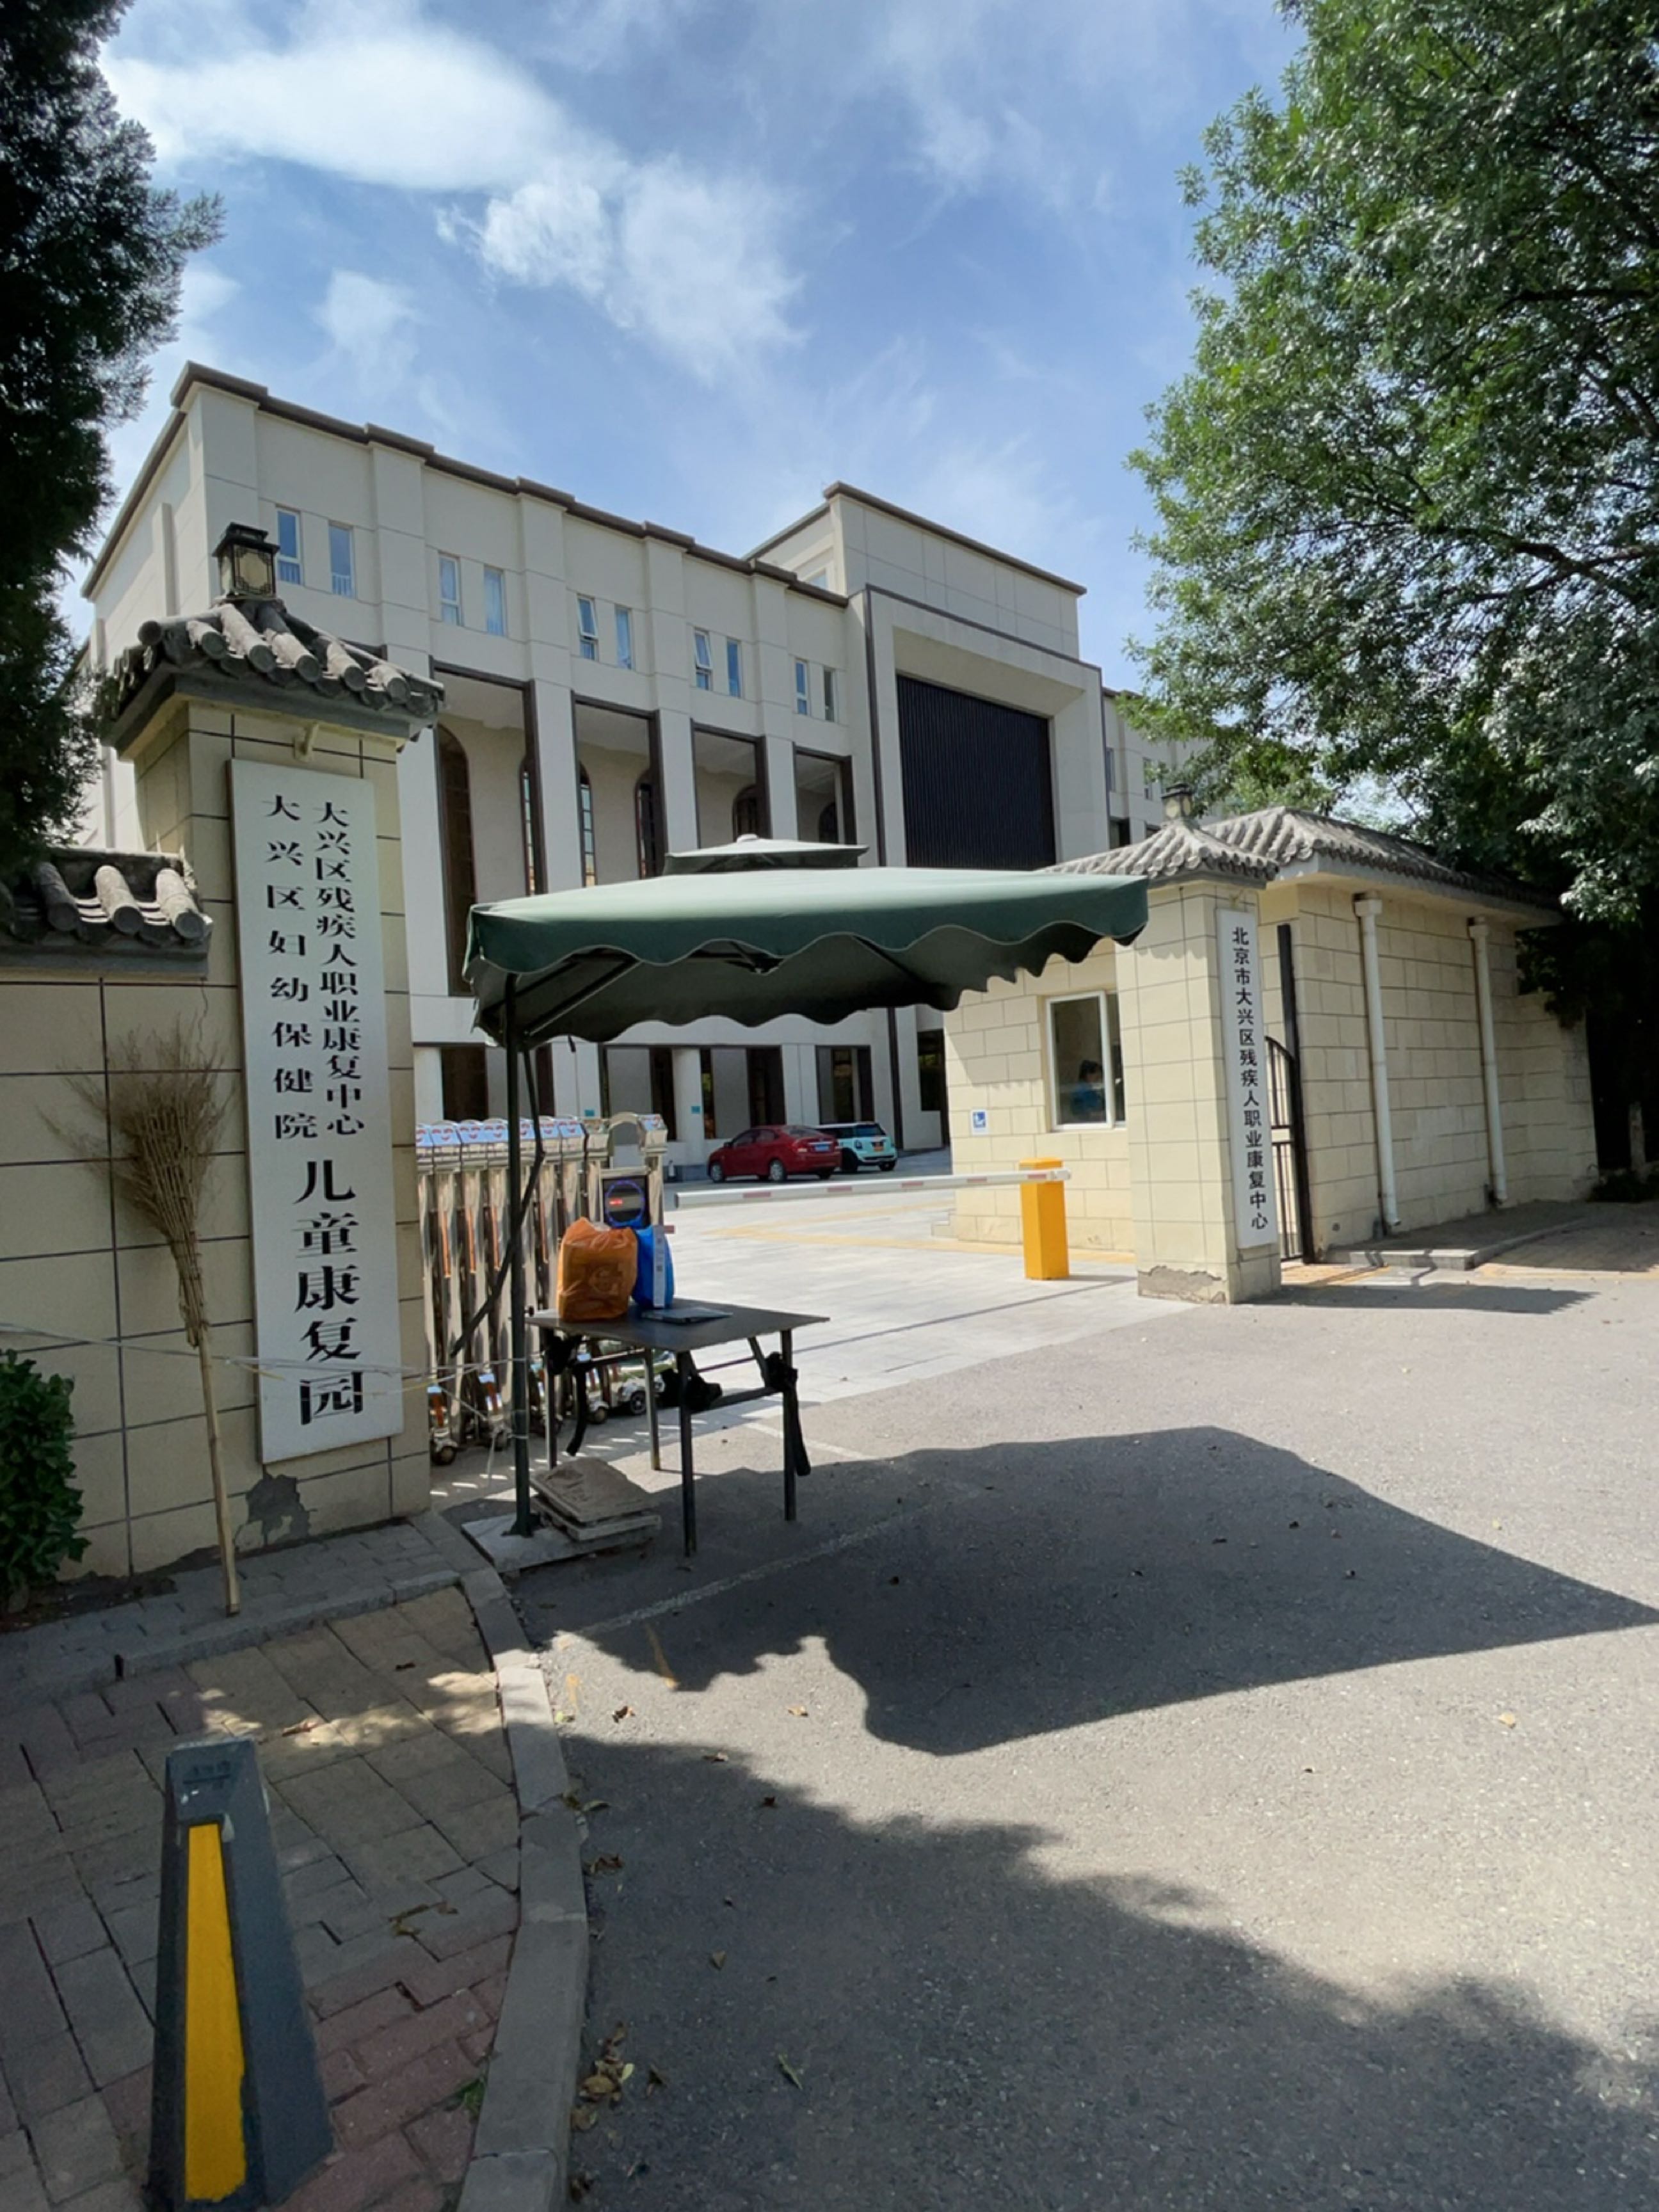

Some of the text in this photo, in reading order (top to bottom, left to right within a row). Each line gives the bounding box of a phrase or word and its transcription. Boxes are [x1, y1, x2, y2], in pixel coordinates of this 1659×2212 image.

[262, 794, 318, 1140] 大兴区妇幼保健院
[314, 801, 365, 1136] 大兴区残疾人职业康复中心
[1232, 926, 1269, 1230] 北京市大兴区残疾人职业康复中心
[293, 1159, 364, 1426] 儿童康复园
